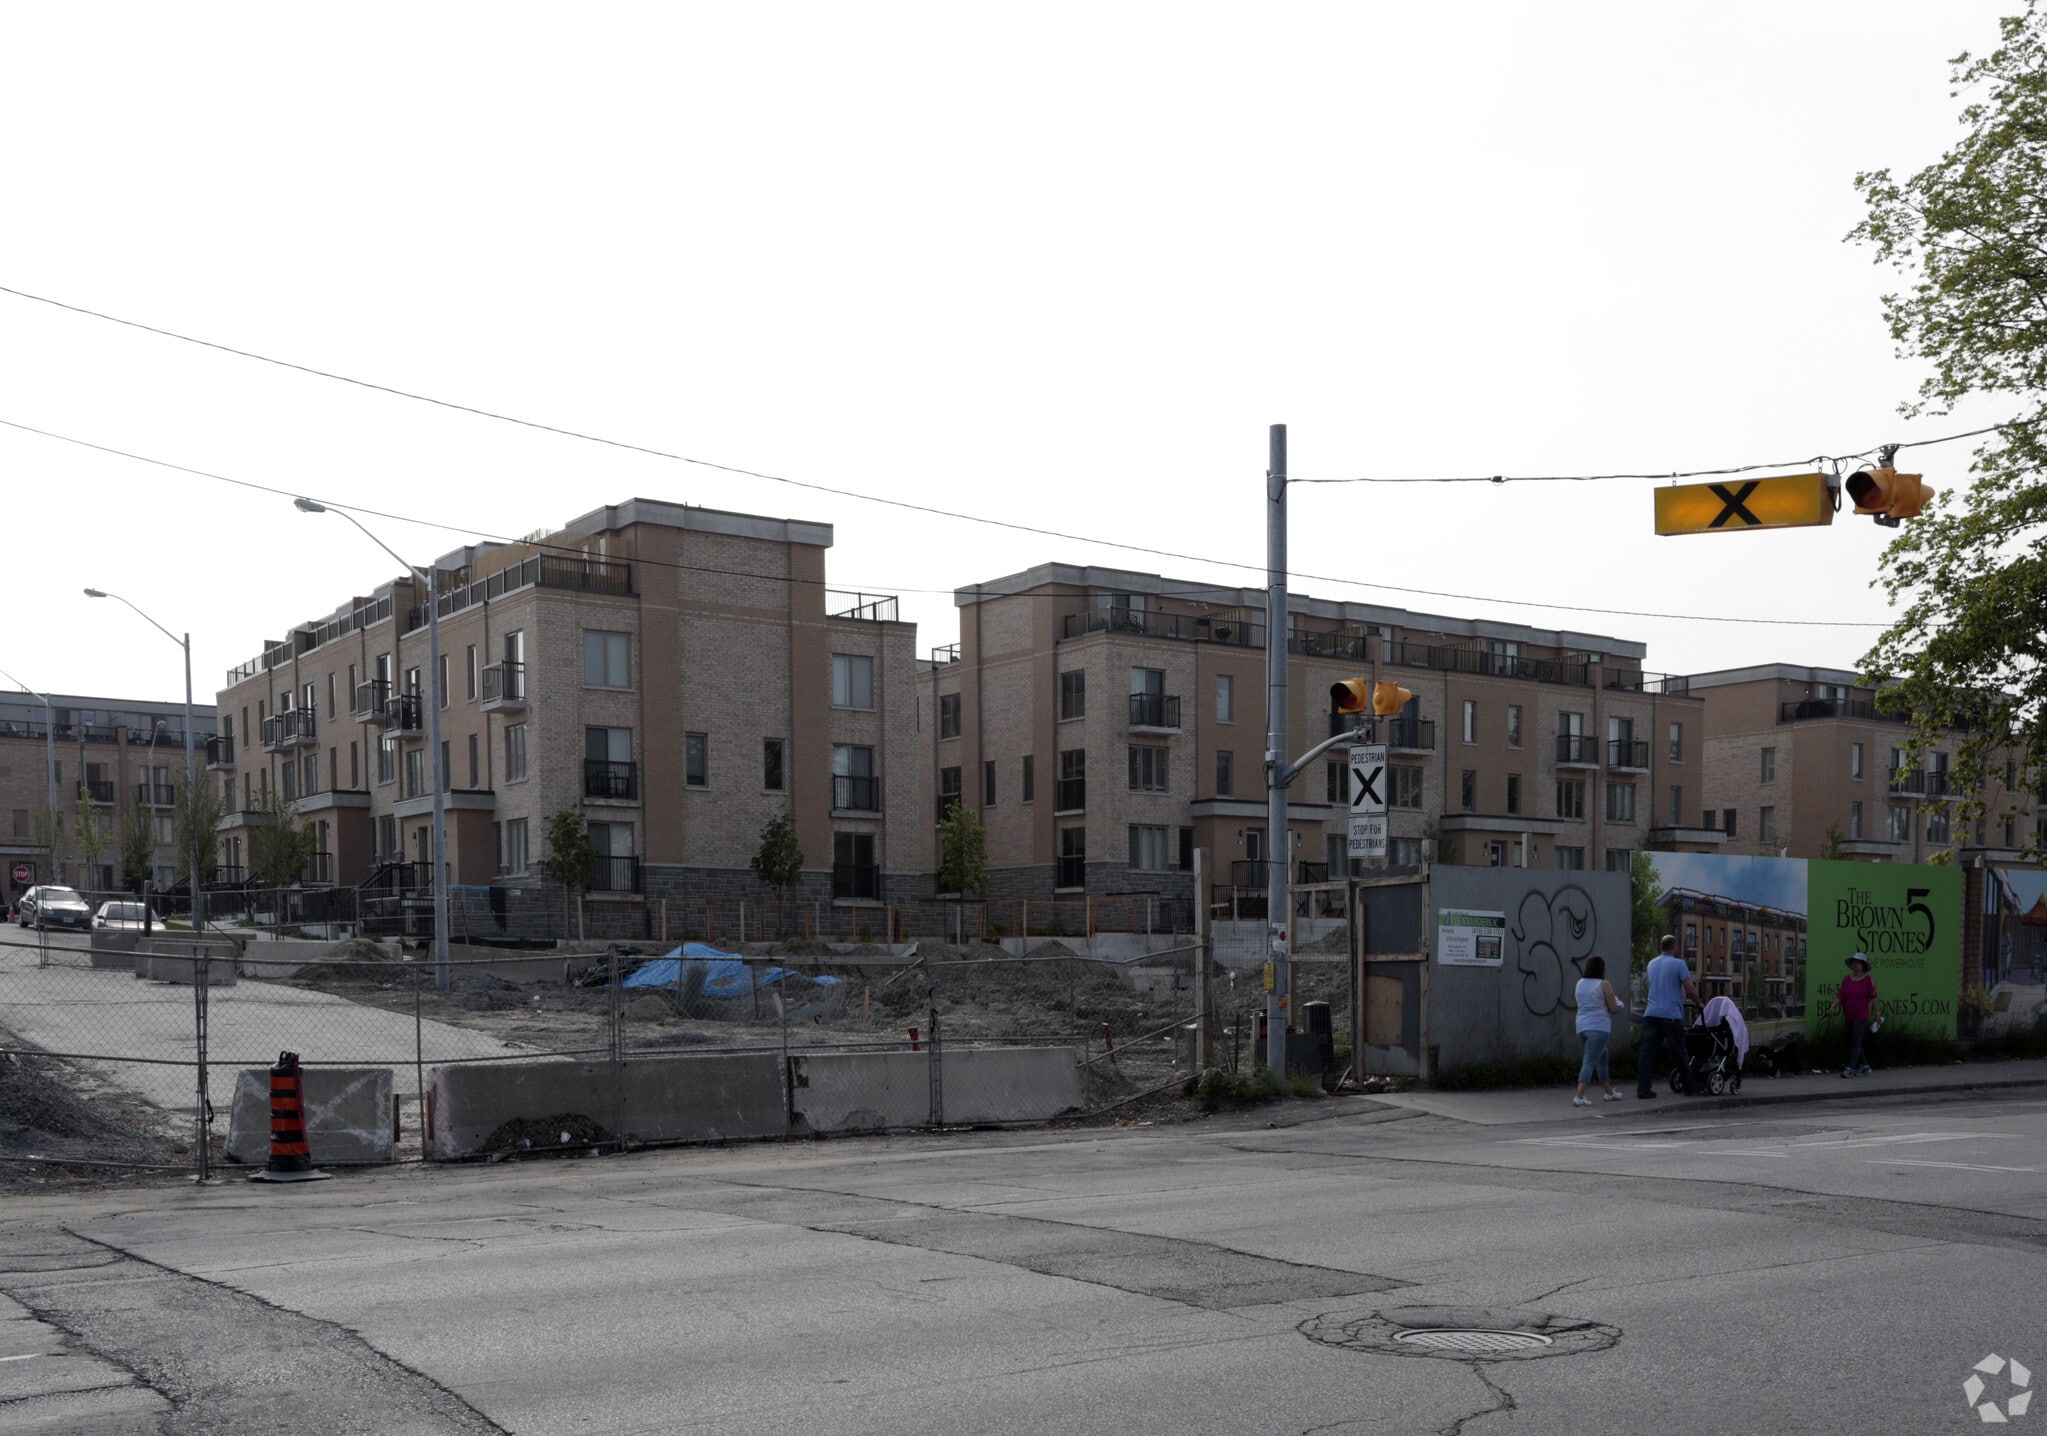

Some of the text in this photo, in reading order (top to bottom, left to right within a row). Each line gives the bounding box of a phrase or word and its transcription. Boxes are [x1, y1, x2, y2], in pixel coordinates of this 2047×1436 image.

[1351, 752, 1385, 764] PEDESTRIAN
[1352, 766, 1384, 806] X
[1353, 824, 1382, 835] STOP FOR
[1348, 838, 1385, 850] PEDESTRIANS
[14, 870, 28, 878] STOP
[1848, 888, 1871, 905] THE
[1836, 888, 1935, 951] BROWN 5
[1856, 925, 1926, 953] STONES
[1880, 958, 1925, 969] POWERHOUSE
